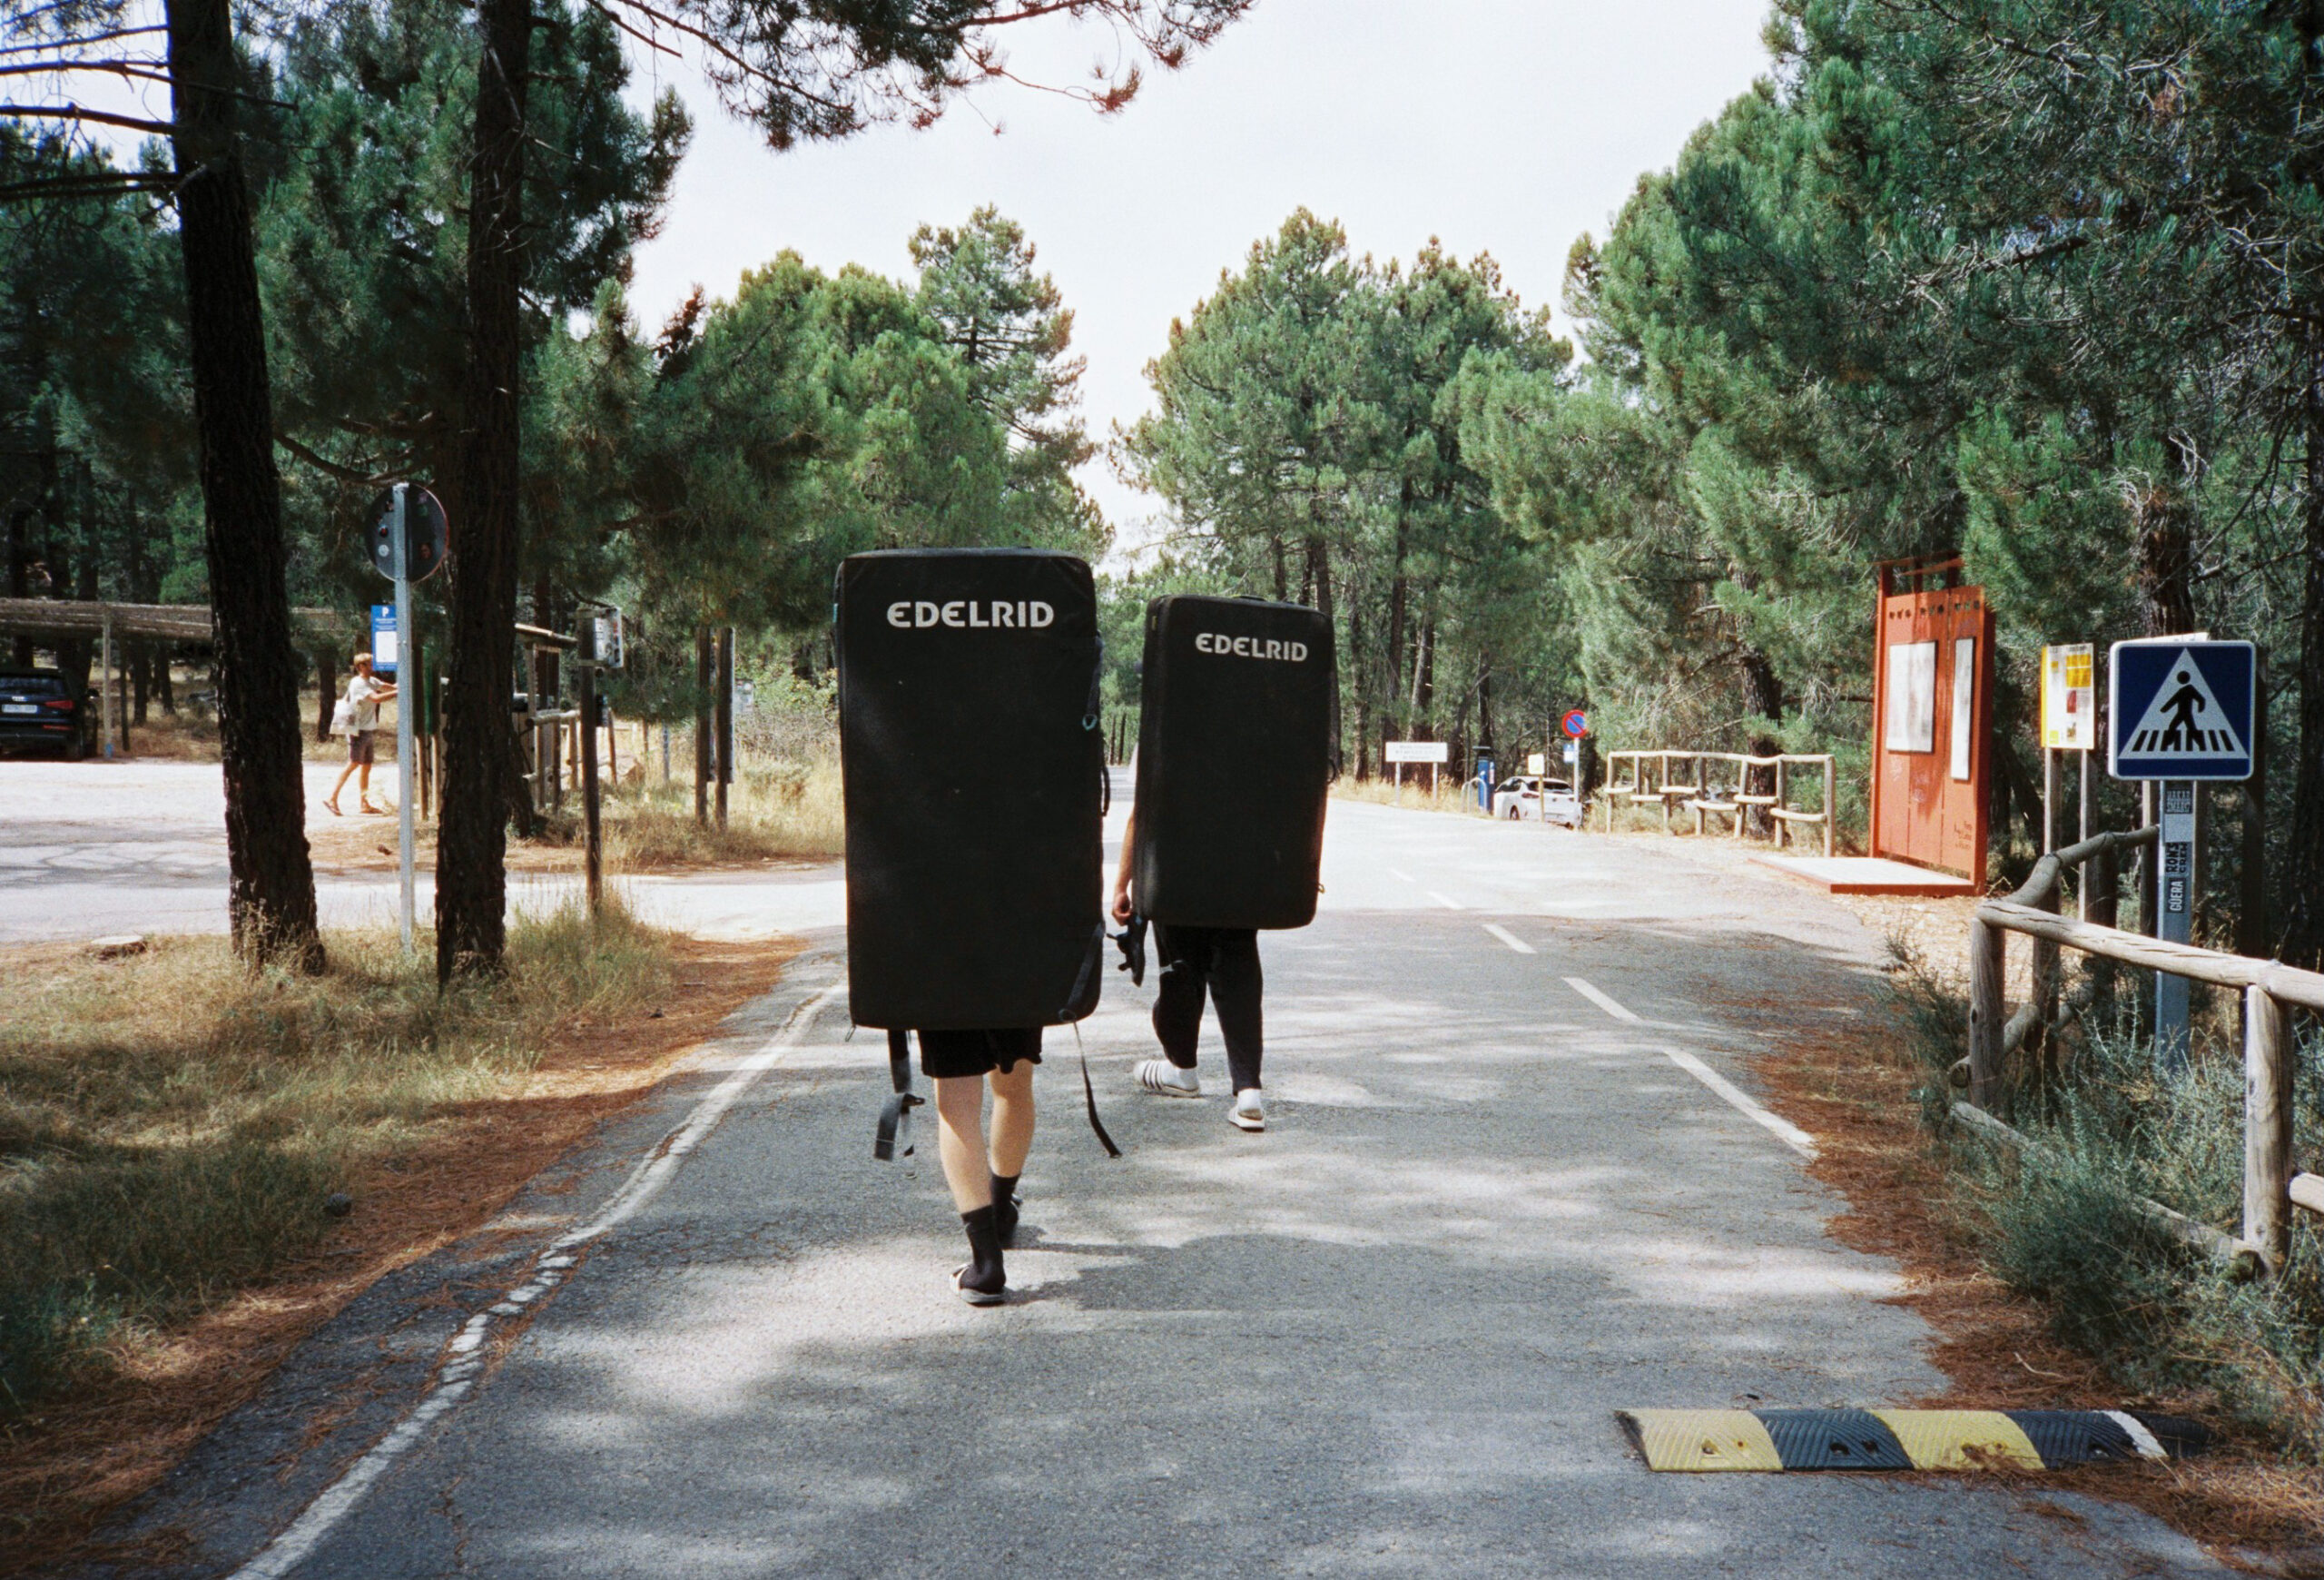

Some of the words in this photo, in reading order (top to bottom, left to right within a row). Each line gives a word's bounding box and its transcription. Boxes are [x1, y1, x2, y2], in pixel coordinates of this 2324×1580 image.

[382, 607, 389, 617] P
[886, 600, 1055, 628] EDELRID
[1195, 633, 1308, 662] EDELRID
